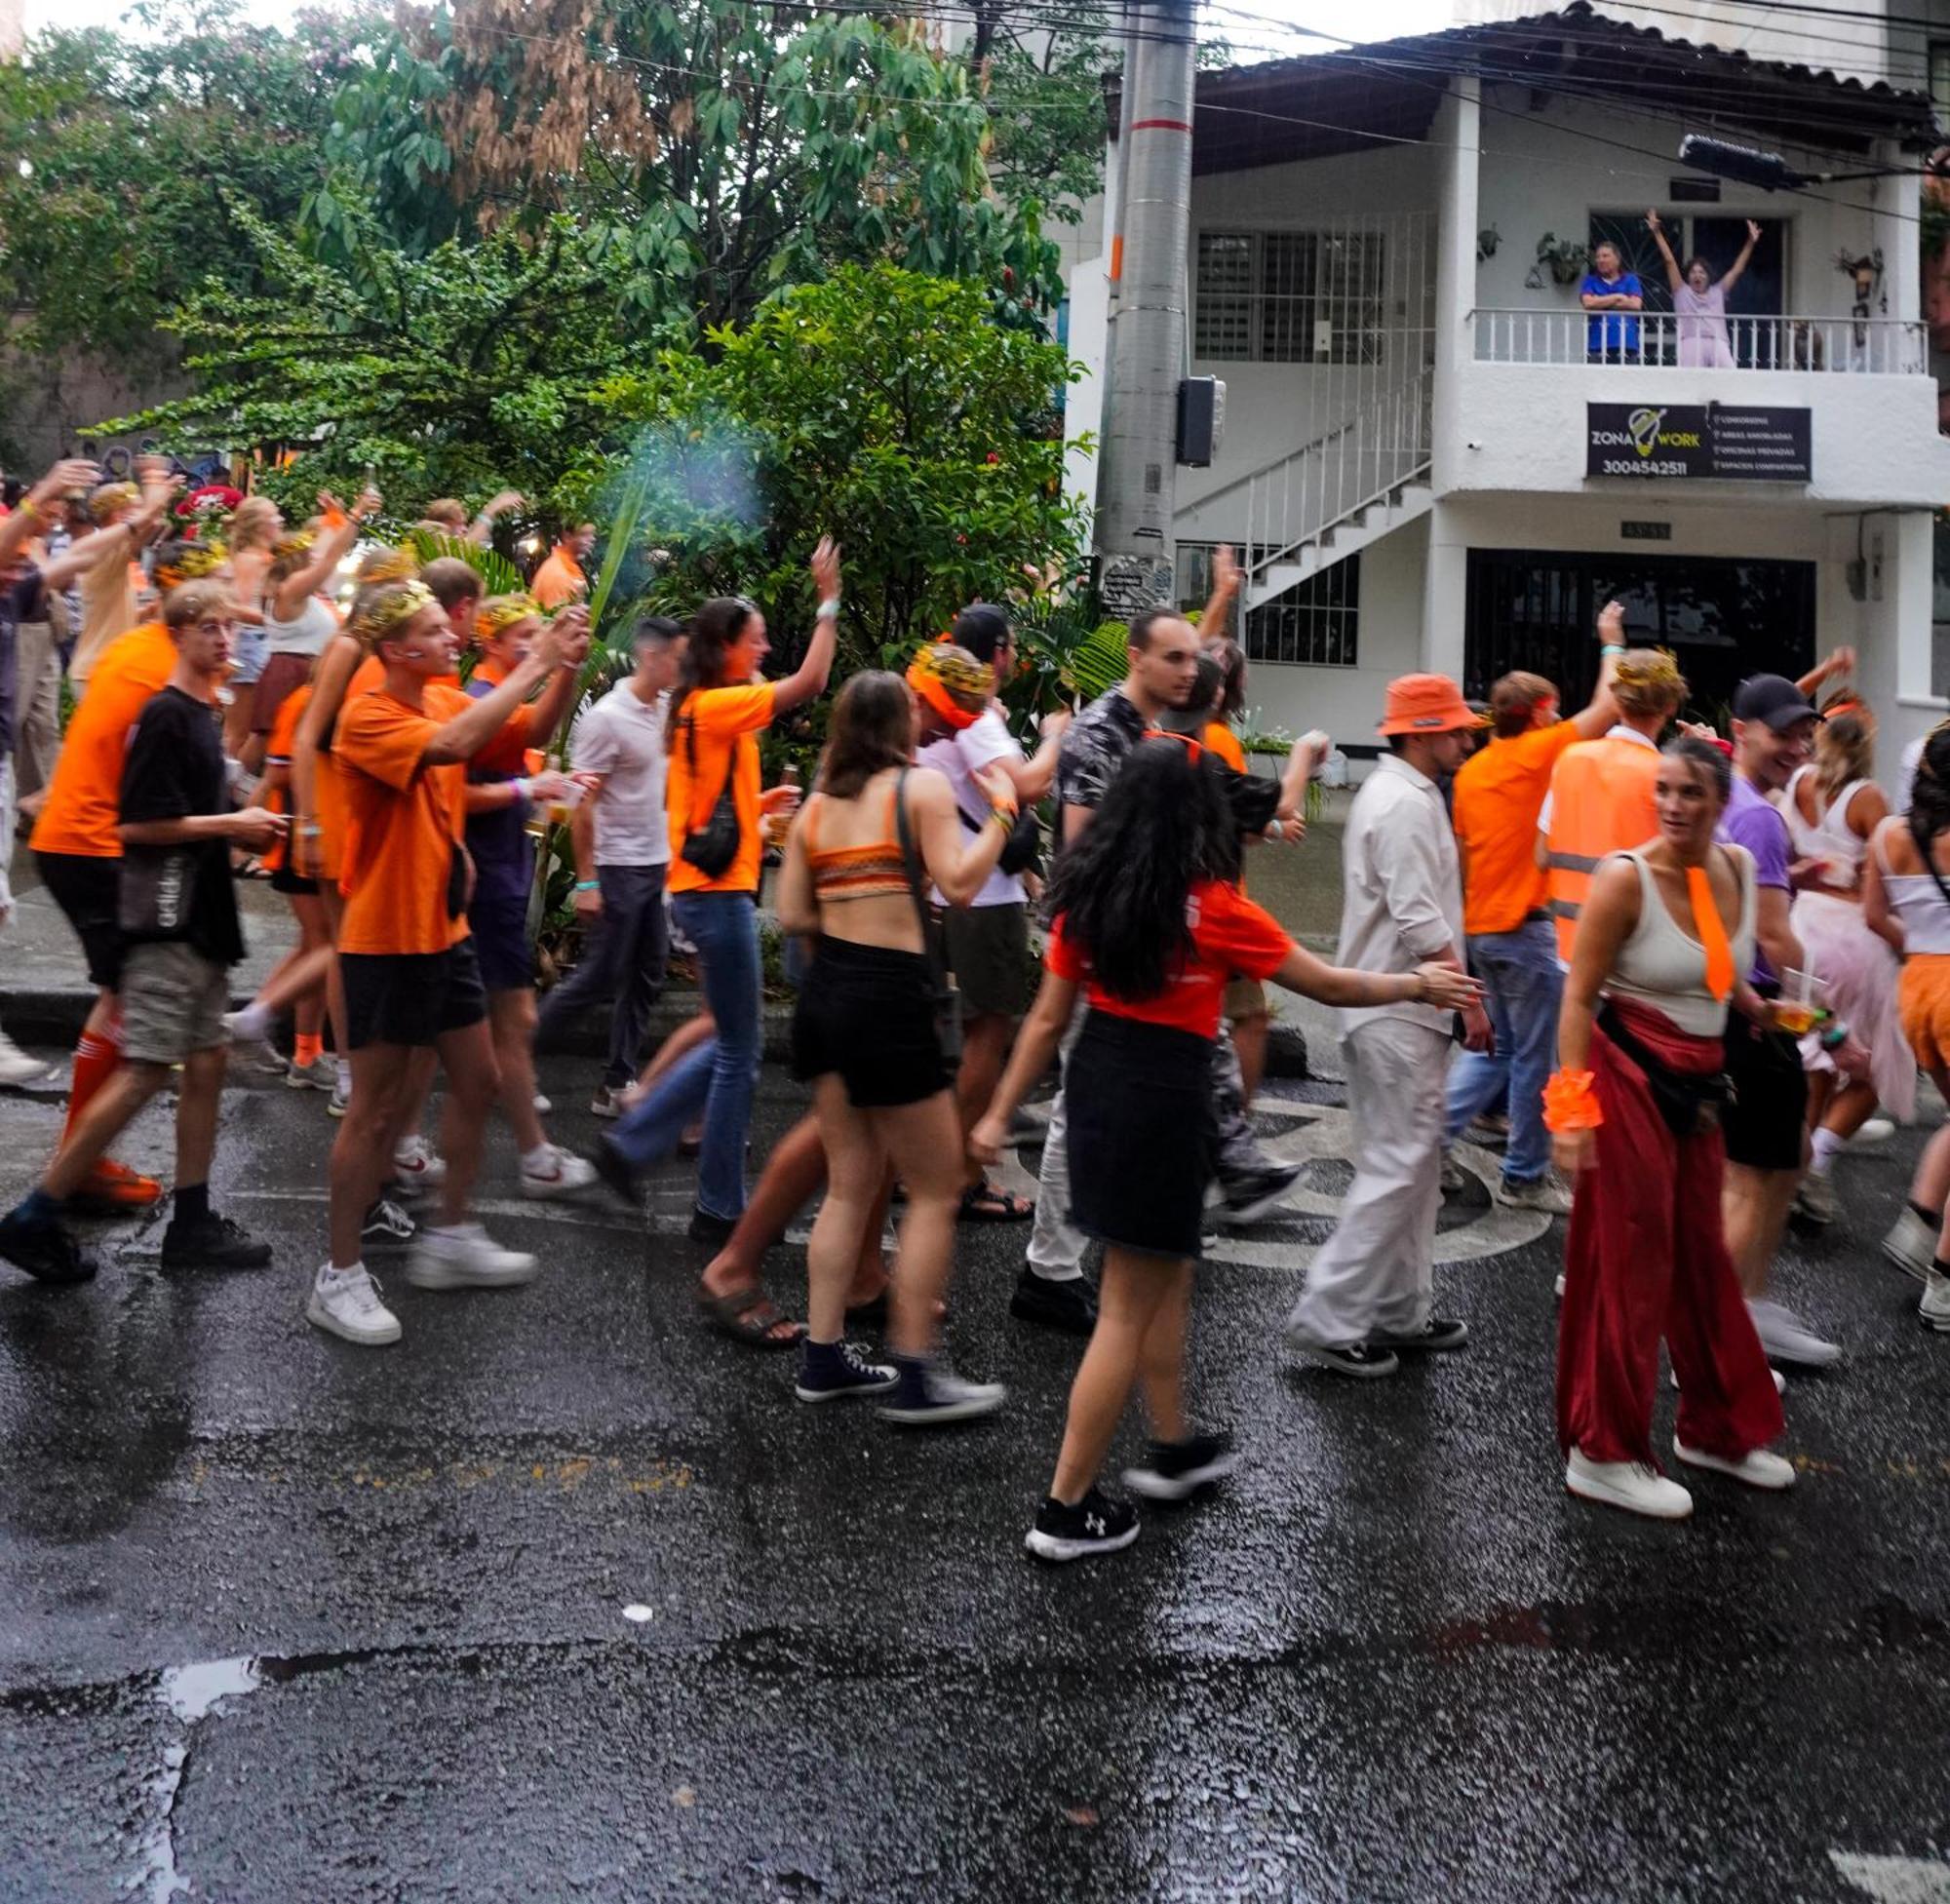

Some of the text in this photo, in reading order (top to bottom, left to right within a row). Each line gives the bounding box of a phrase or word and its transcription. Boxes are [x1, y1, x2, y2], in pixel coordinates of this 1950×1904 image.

[1591, 431, 1700, 447] ZONA WORK
[1603, 460, 1687, 476] 3004542511
[156, 857, 183, 927] adidas
